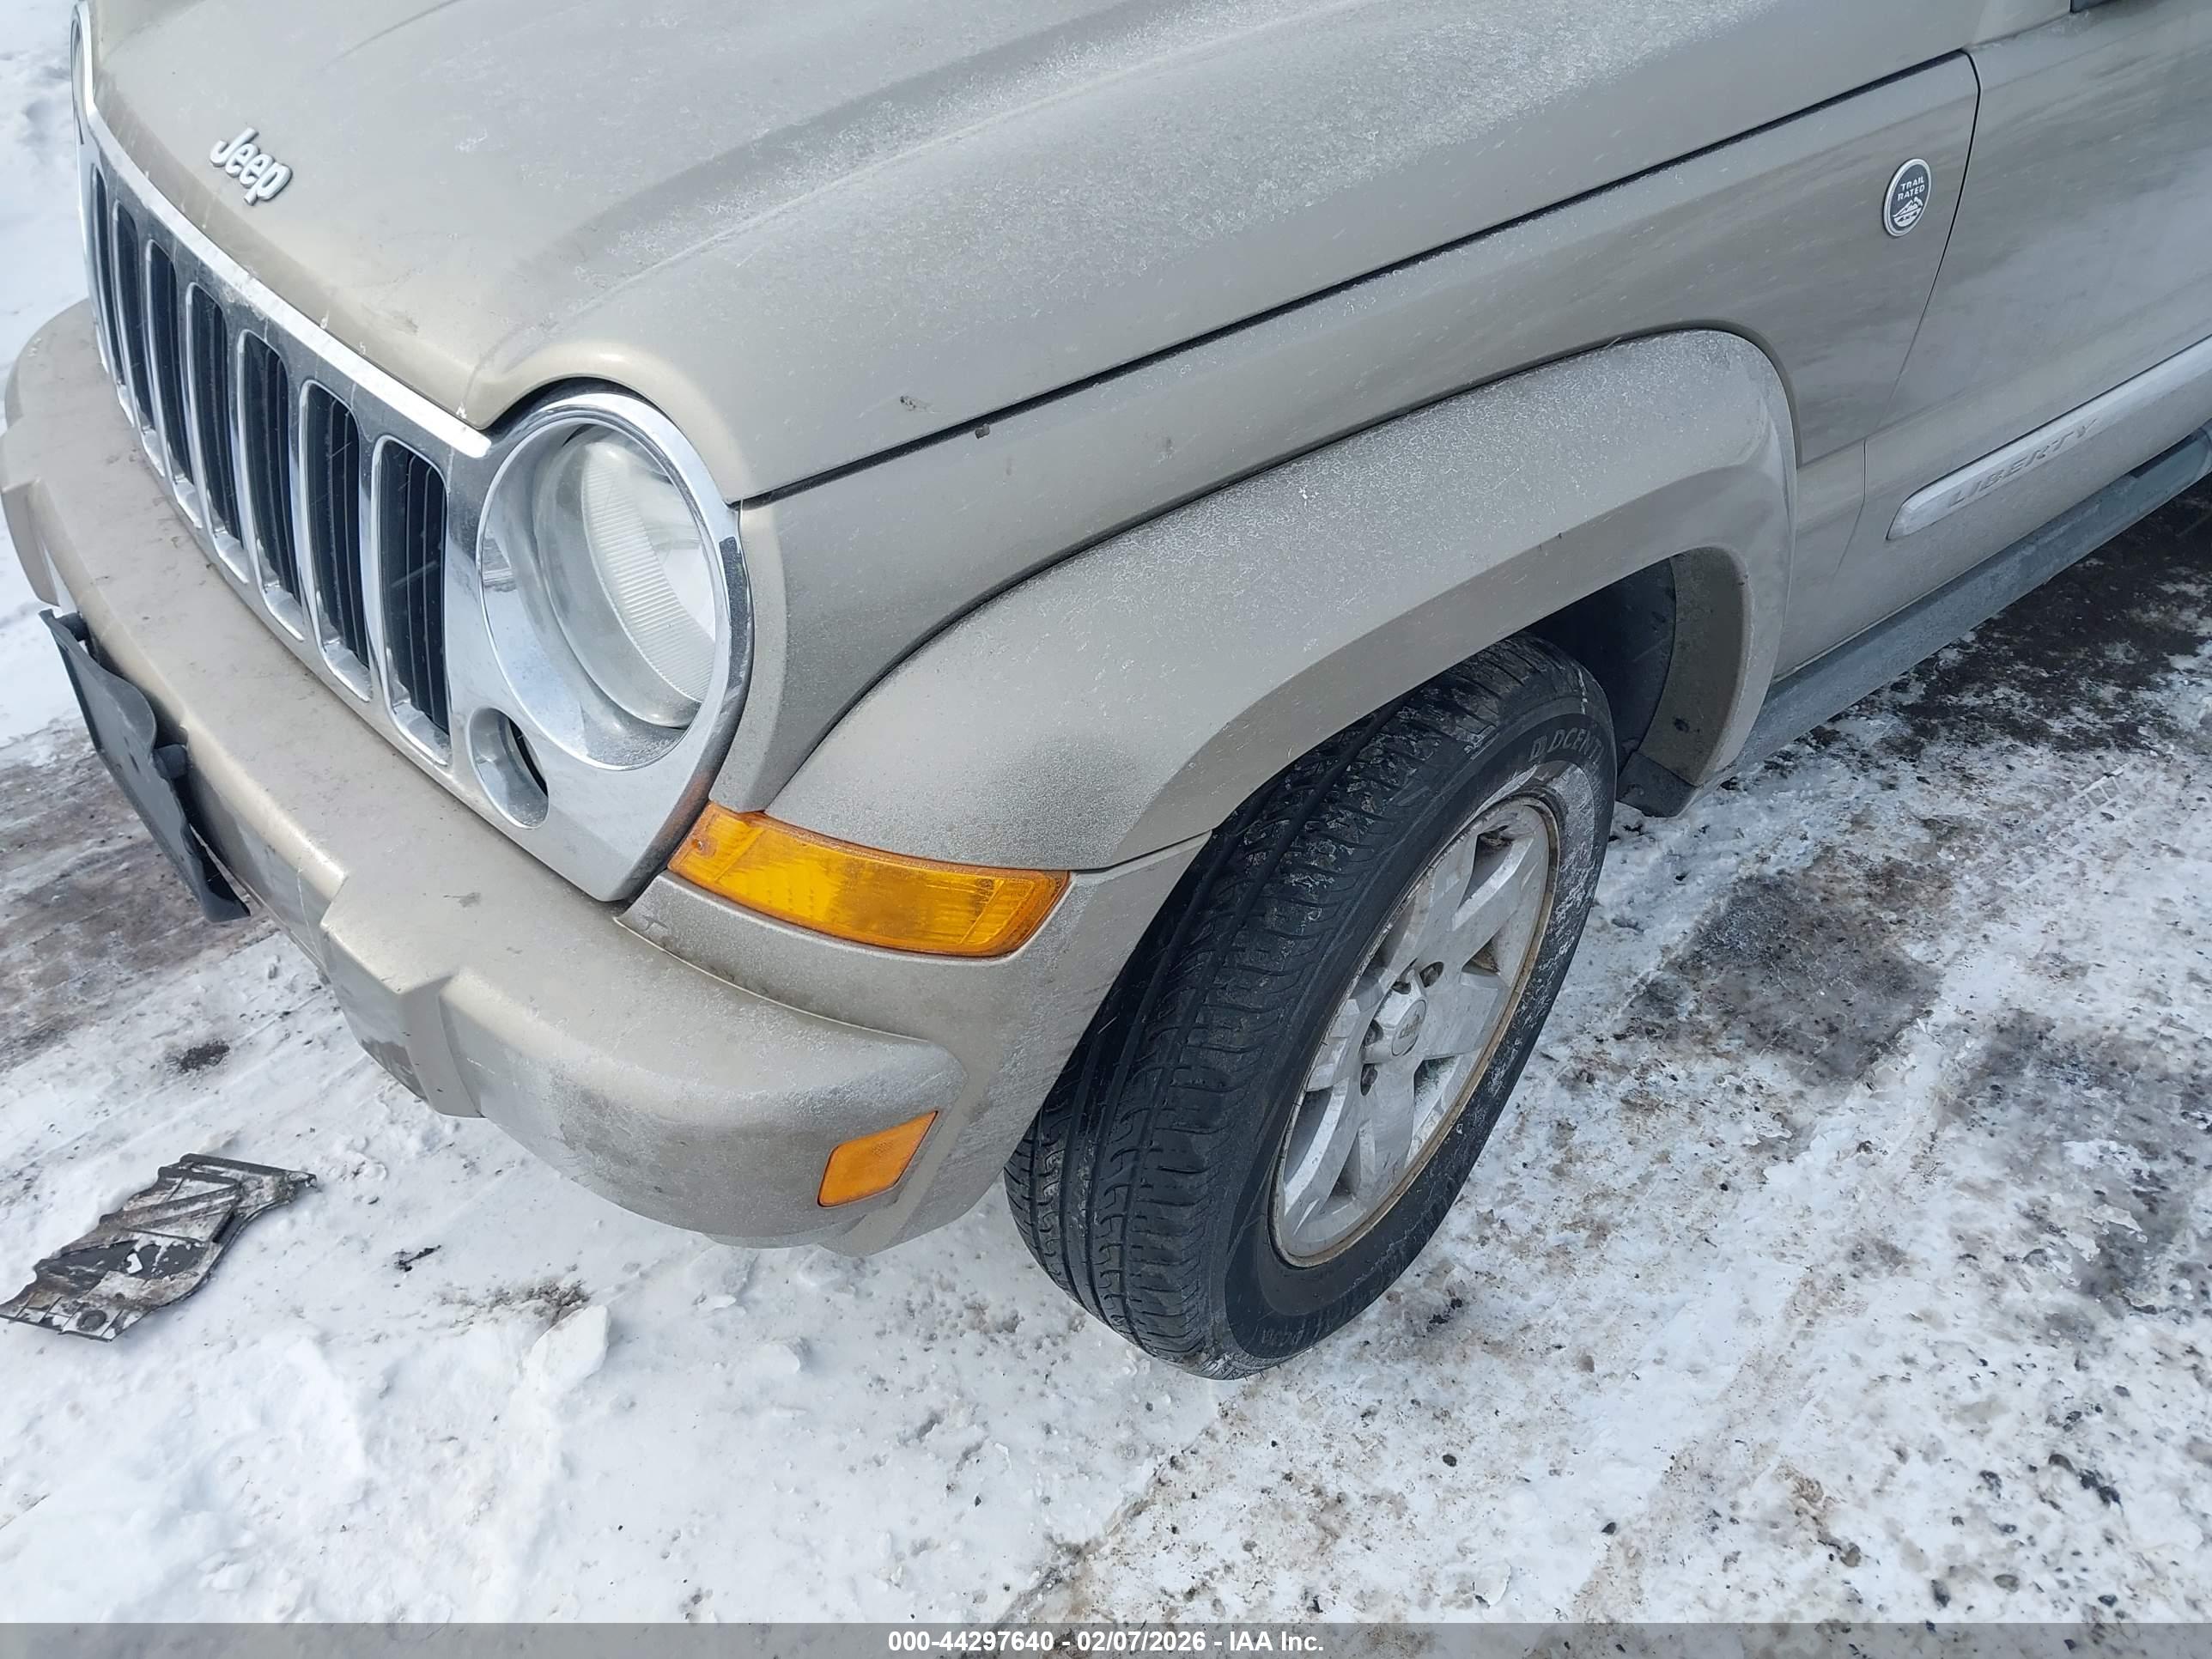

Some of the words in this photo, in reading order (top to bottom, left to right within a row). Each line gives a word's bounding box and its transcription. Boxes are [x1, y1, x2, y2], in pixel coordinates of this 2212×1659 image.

[210, 127, 294, 207] Jeep
[1900, 175, 1925, 191] TRAIL
[1897, 184, 1926, 202] RATED
[1947, 417, 2099, 509] LIBERTY
